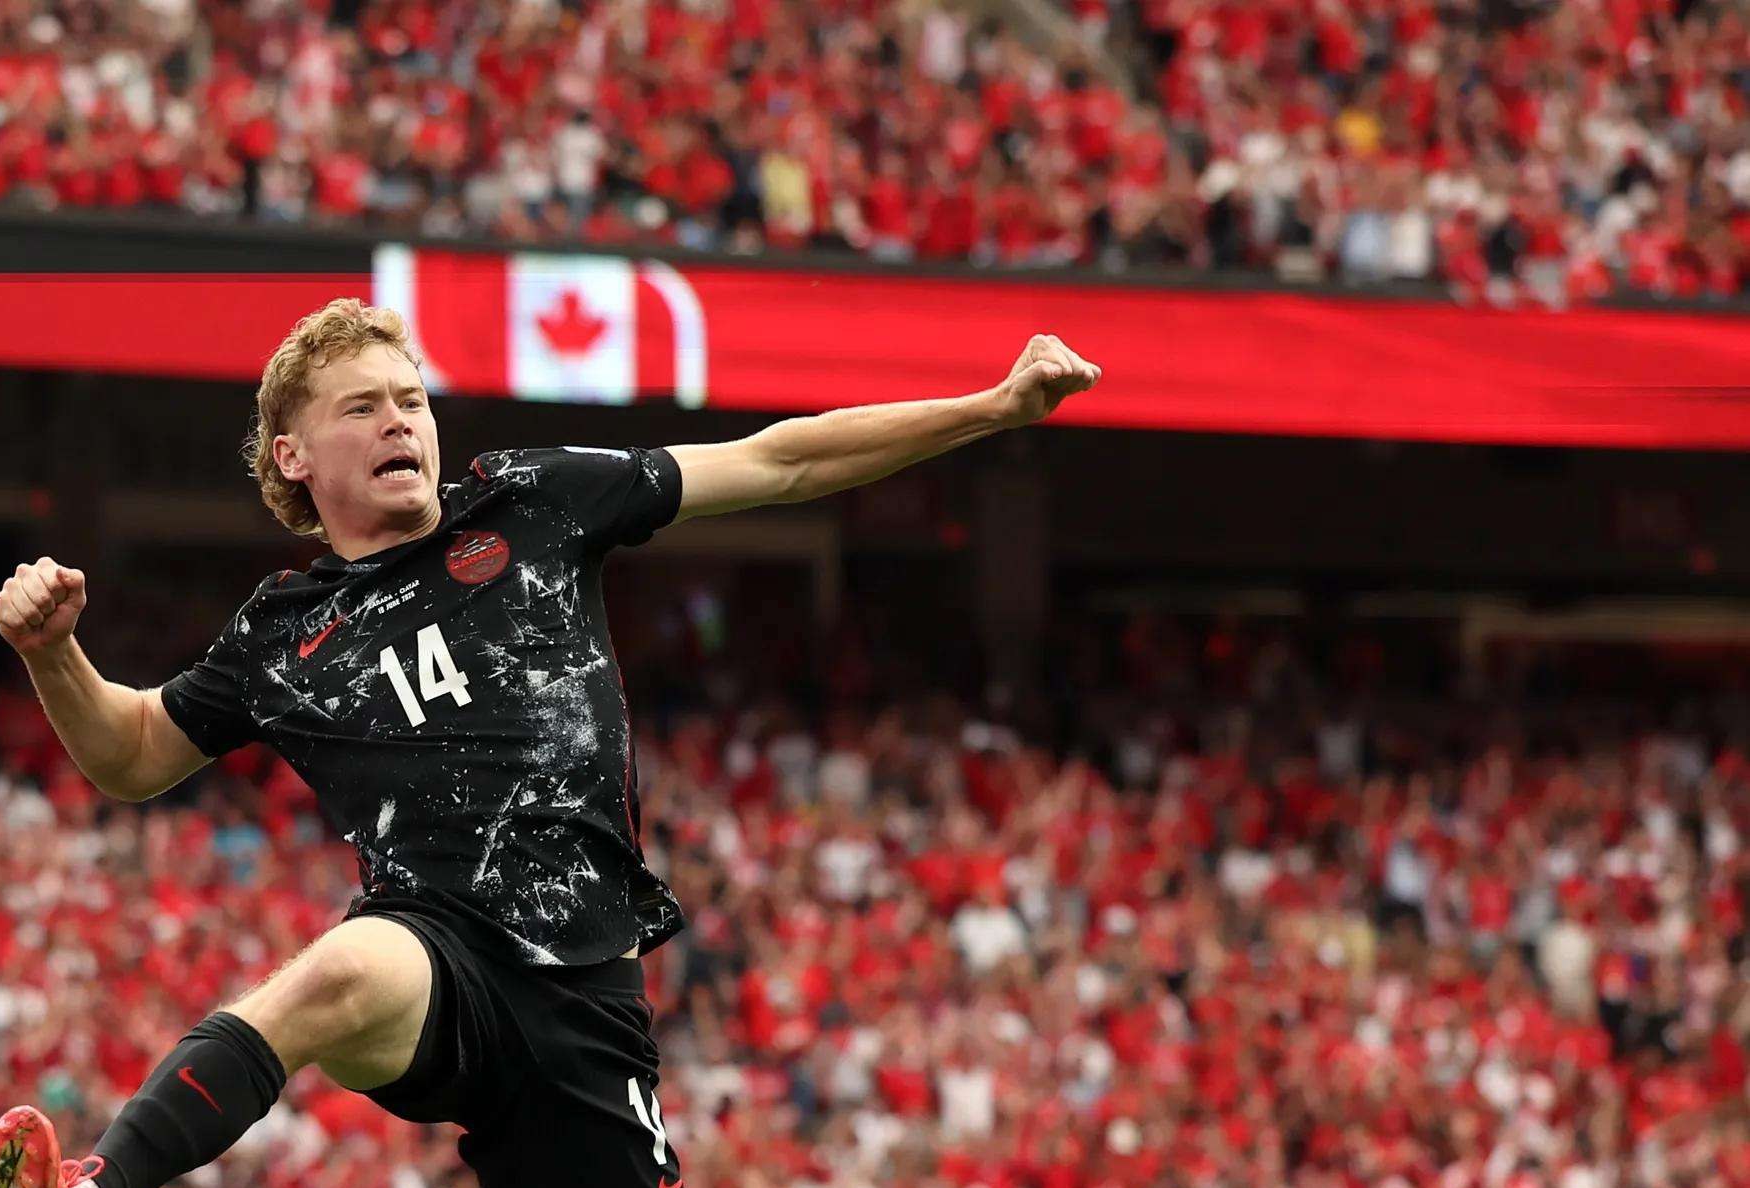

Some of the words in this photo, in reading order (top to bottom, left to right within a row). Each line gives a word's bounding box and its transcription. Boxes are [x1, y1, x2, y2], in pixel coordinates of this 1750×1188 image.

[448, 544, 504, 570] CANADA
[399, 579, 420, 594] QATAR
[386, 599, 401, 611] JUNE
[379, 623, 473, 728] 14
